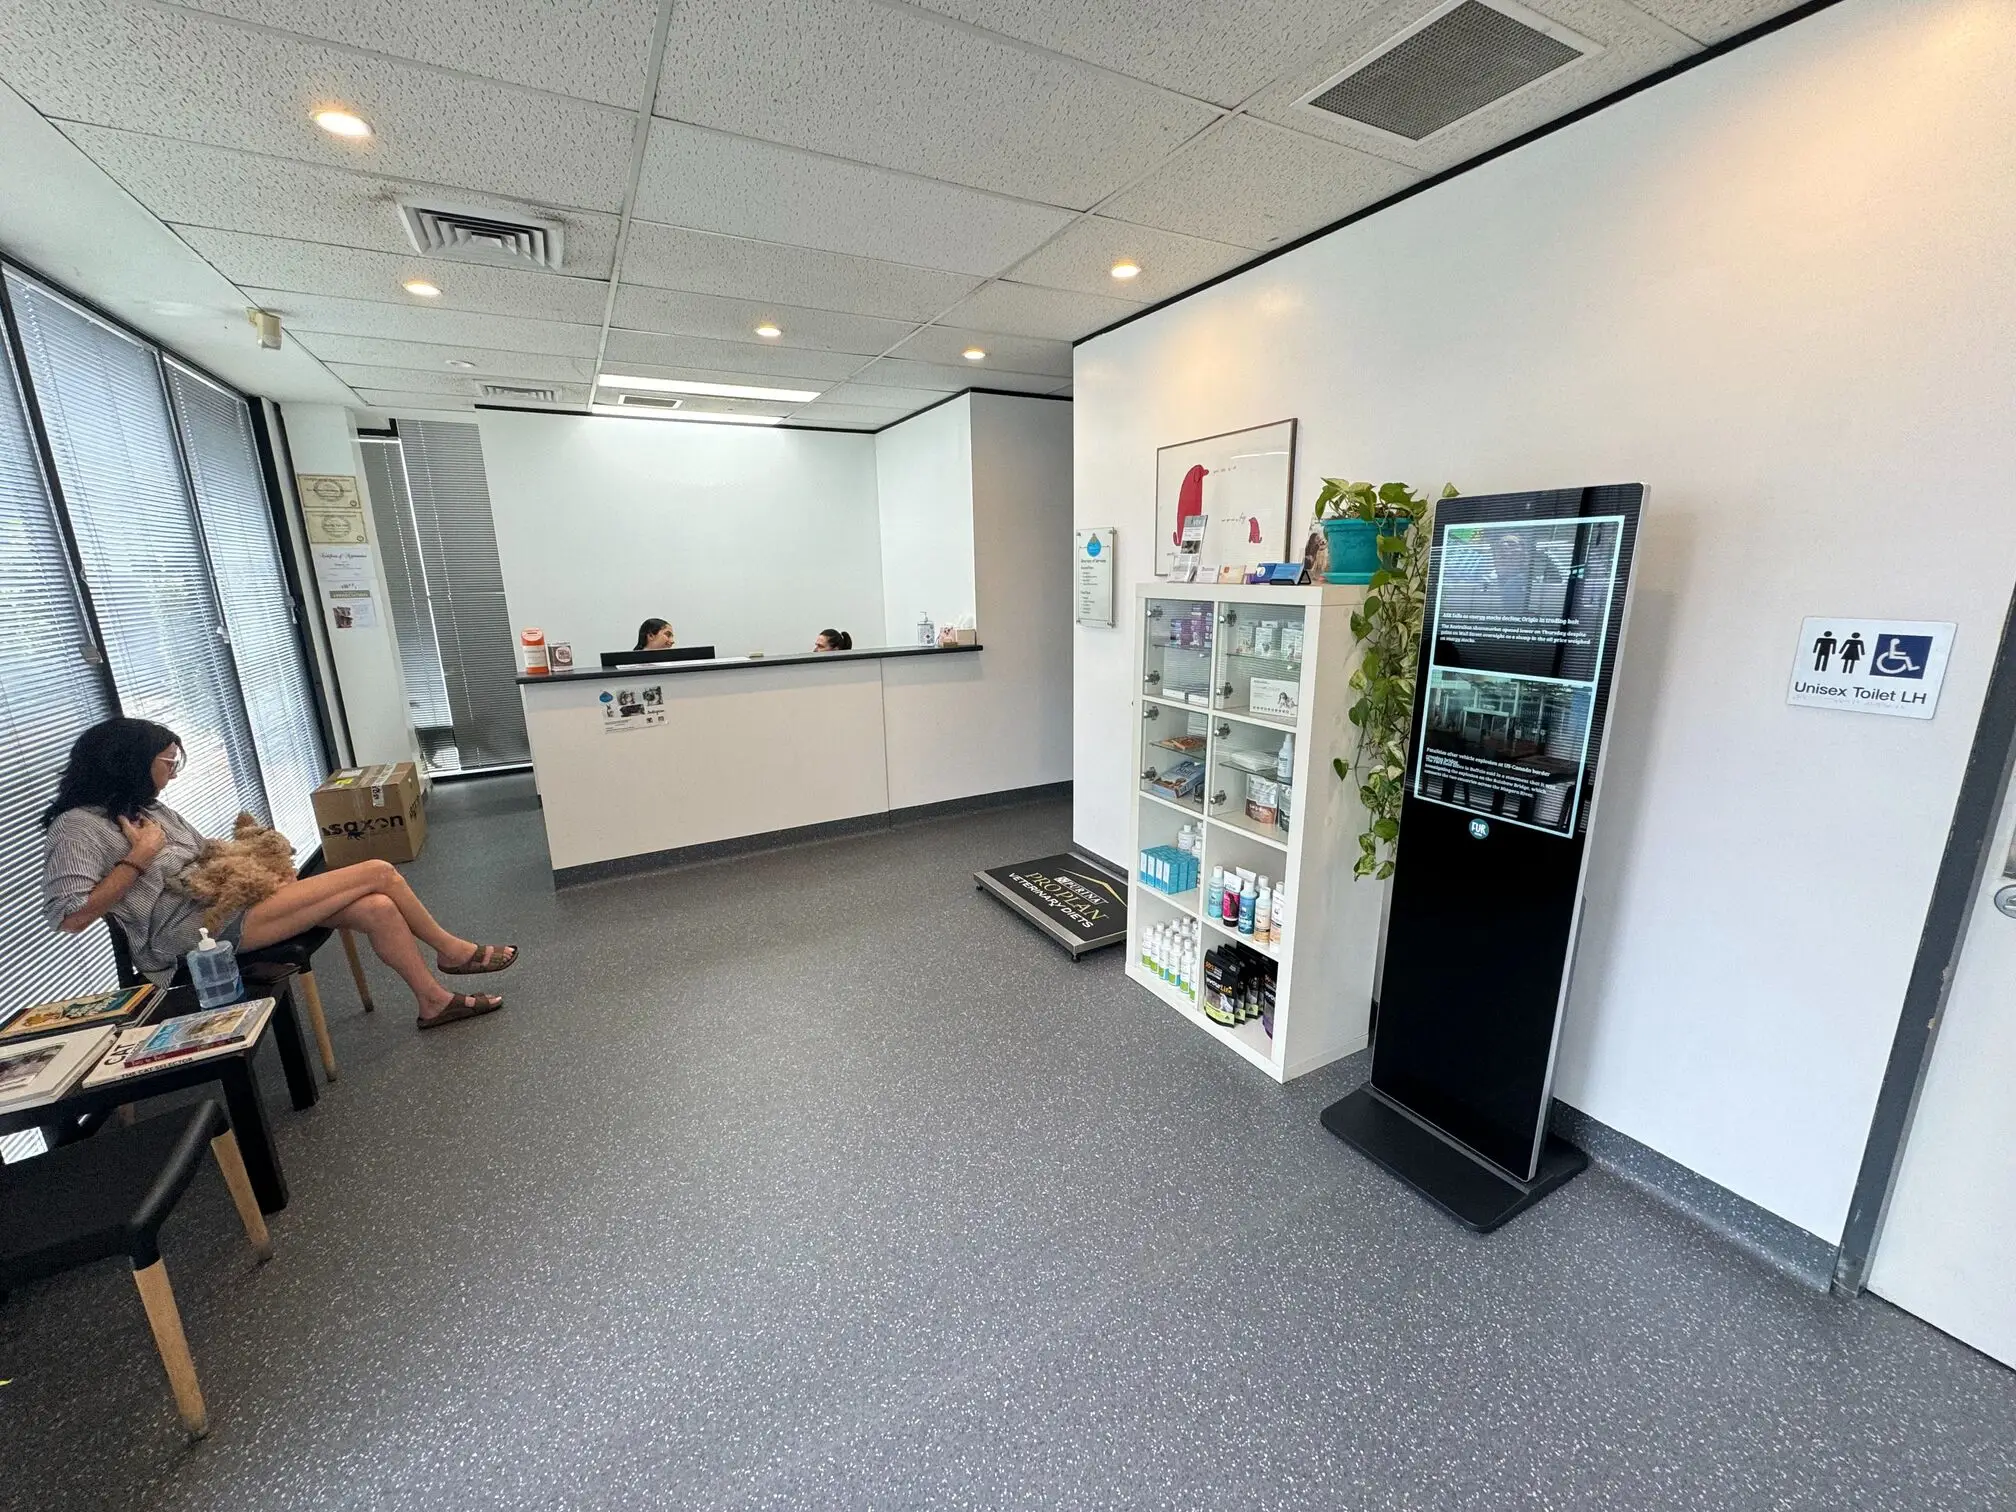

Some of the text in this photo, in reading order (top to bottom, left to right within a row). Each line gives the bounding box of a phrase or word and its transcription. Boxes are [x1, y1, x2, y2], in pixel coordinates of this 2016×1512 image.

[1794, 681, 1927, 704] Unisex Toilet LH
[1472, 822, 1486, 835] FUR
[1008, 872, 1094, 928] VETERINARY DIETS
[1023, 872, 1107, 920] PRO PLAN
[1065, 878, 1102, 903] PURINA
[103, 1043, 136, 1066] CAT
[154, 1056, 193, 1071] SELECTOR
